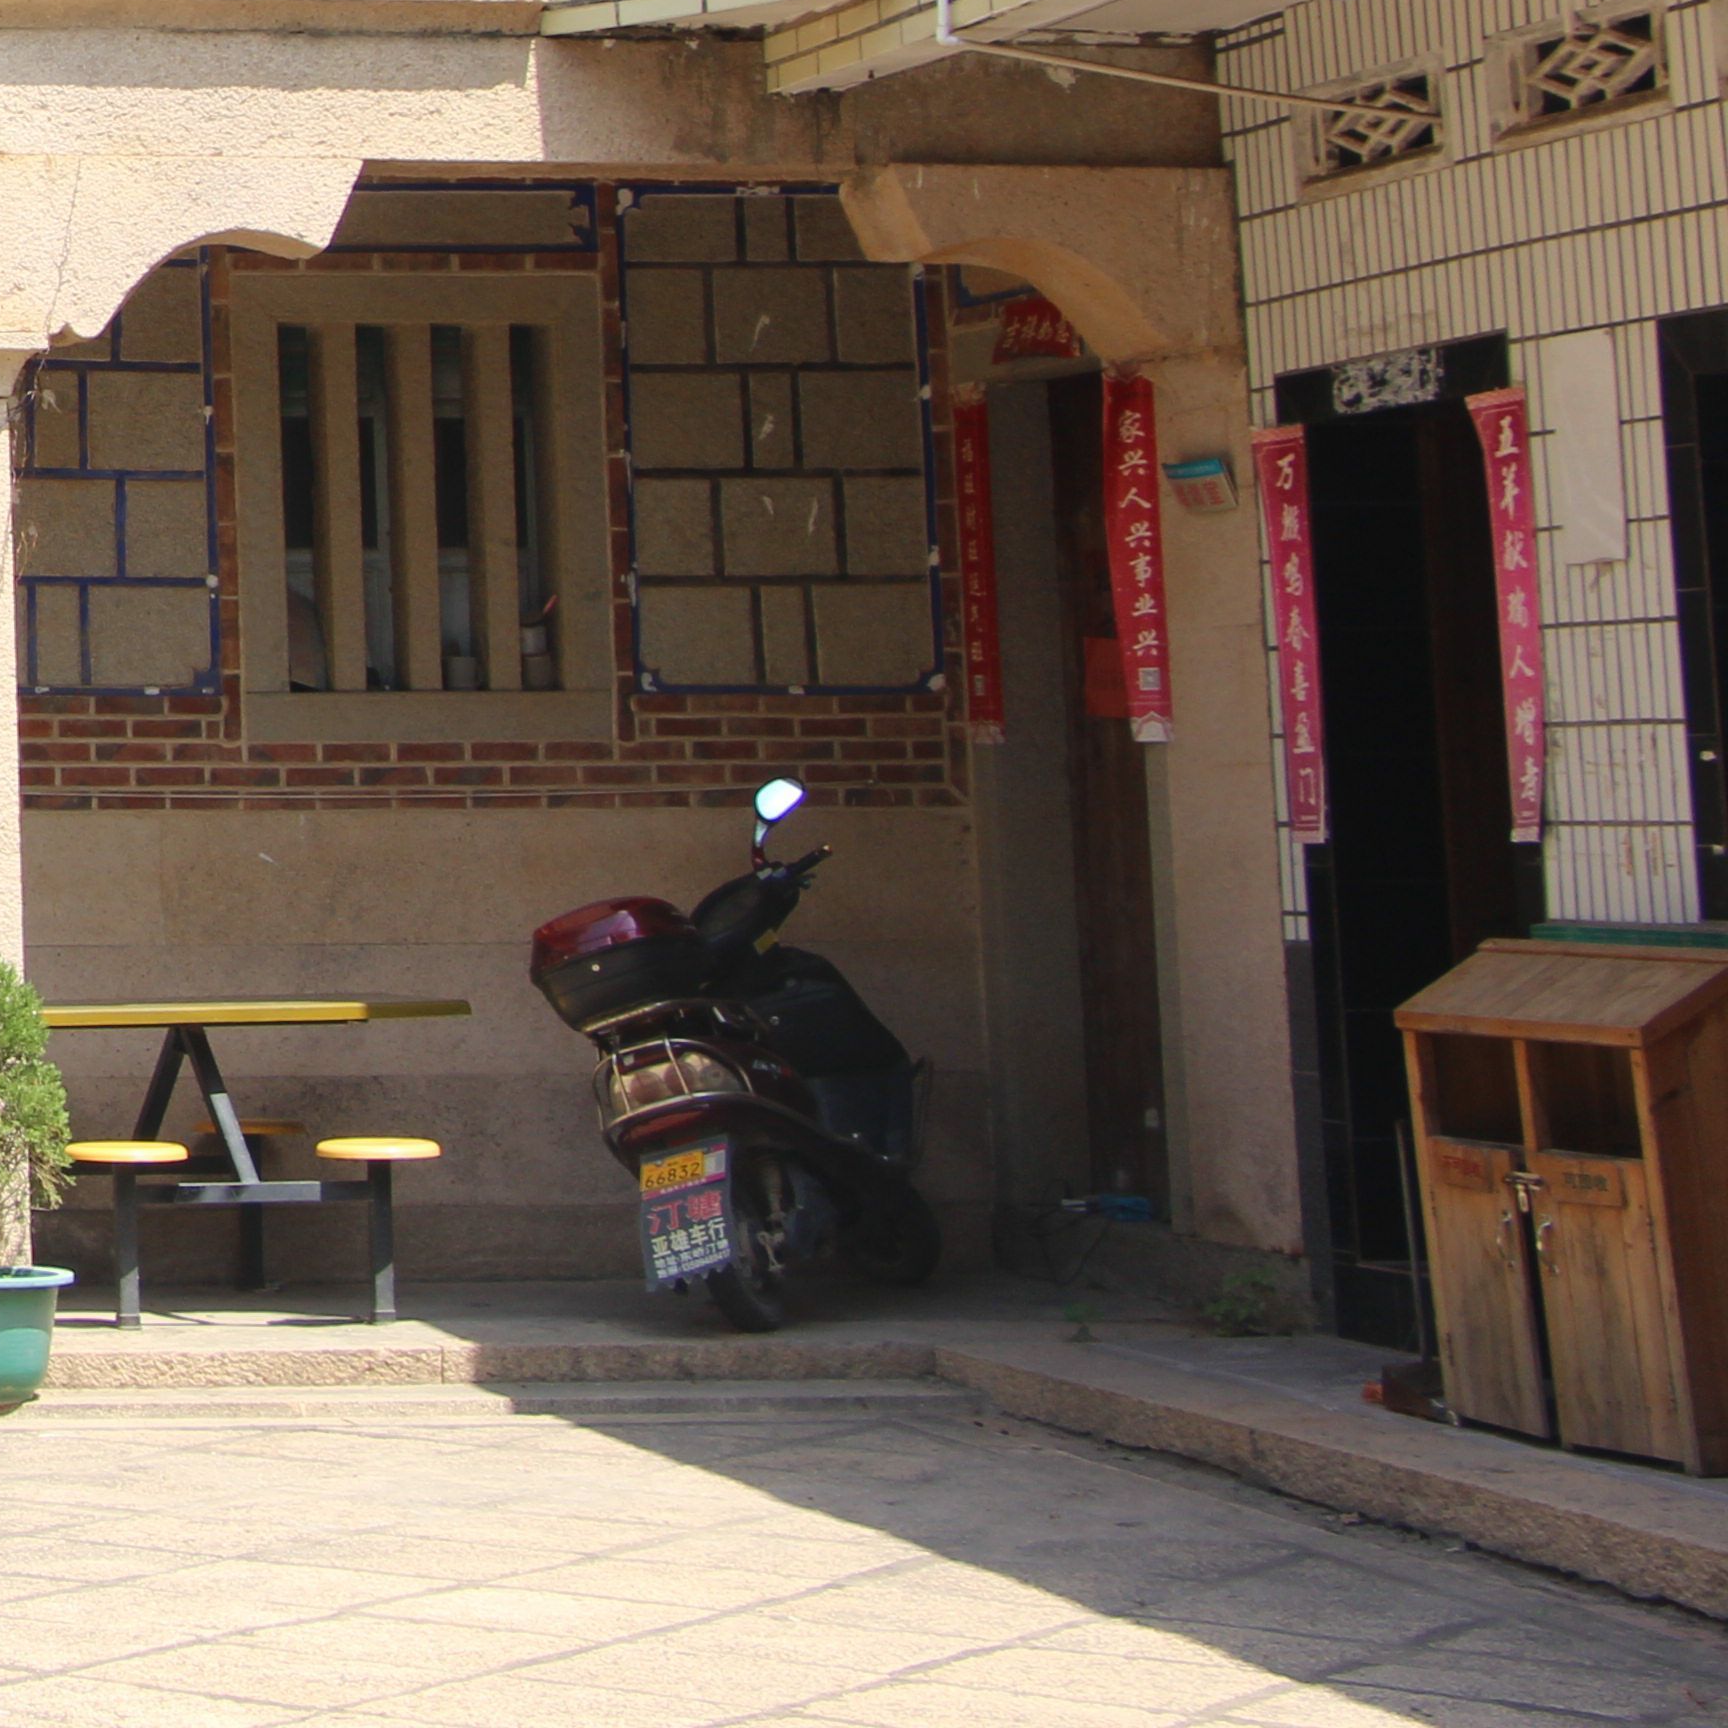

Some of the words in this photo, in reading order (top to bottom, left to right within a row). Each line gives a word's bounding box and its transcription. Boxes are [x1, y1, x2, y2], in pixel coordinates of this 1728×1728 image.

[1117, 410, 1160, 657] 家兴人兴事业兴
[1494, 415, 1540, 803] 五羊献瑞人增寿
[645, 1161, 701, 1189] 66832
[652, 1218, 726, 1257] 亚雄车行
